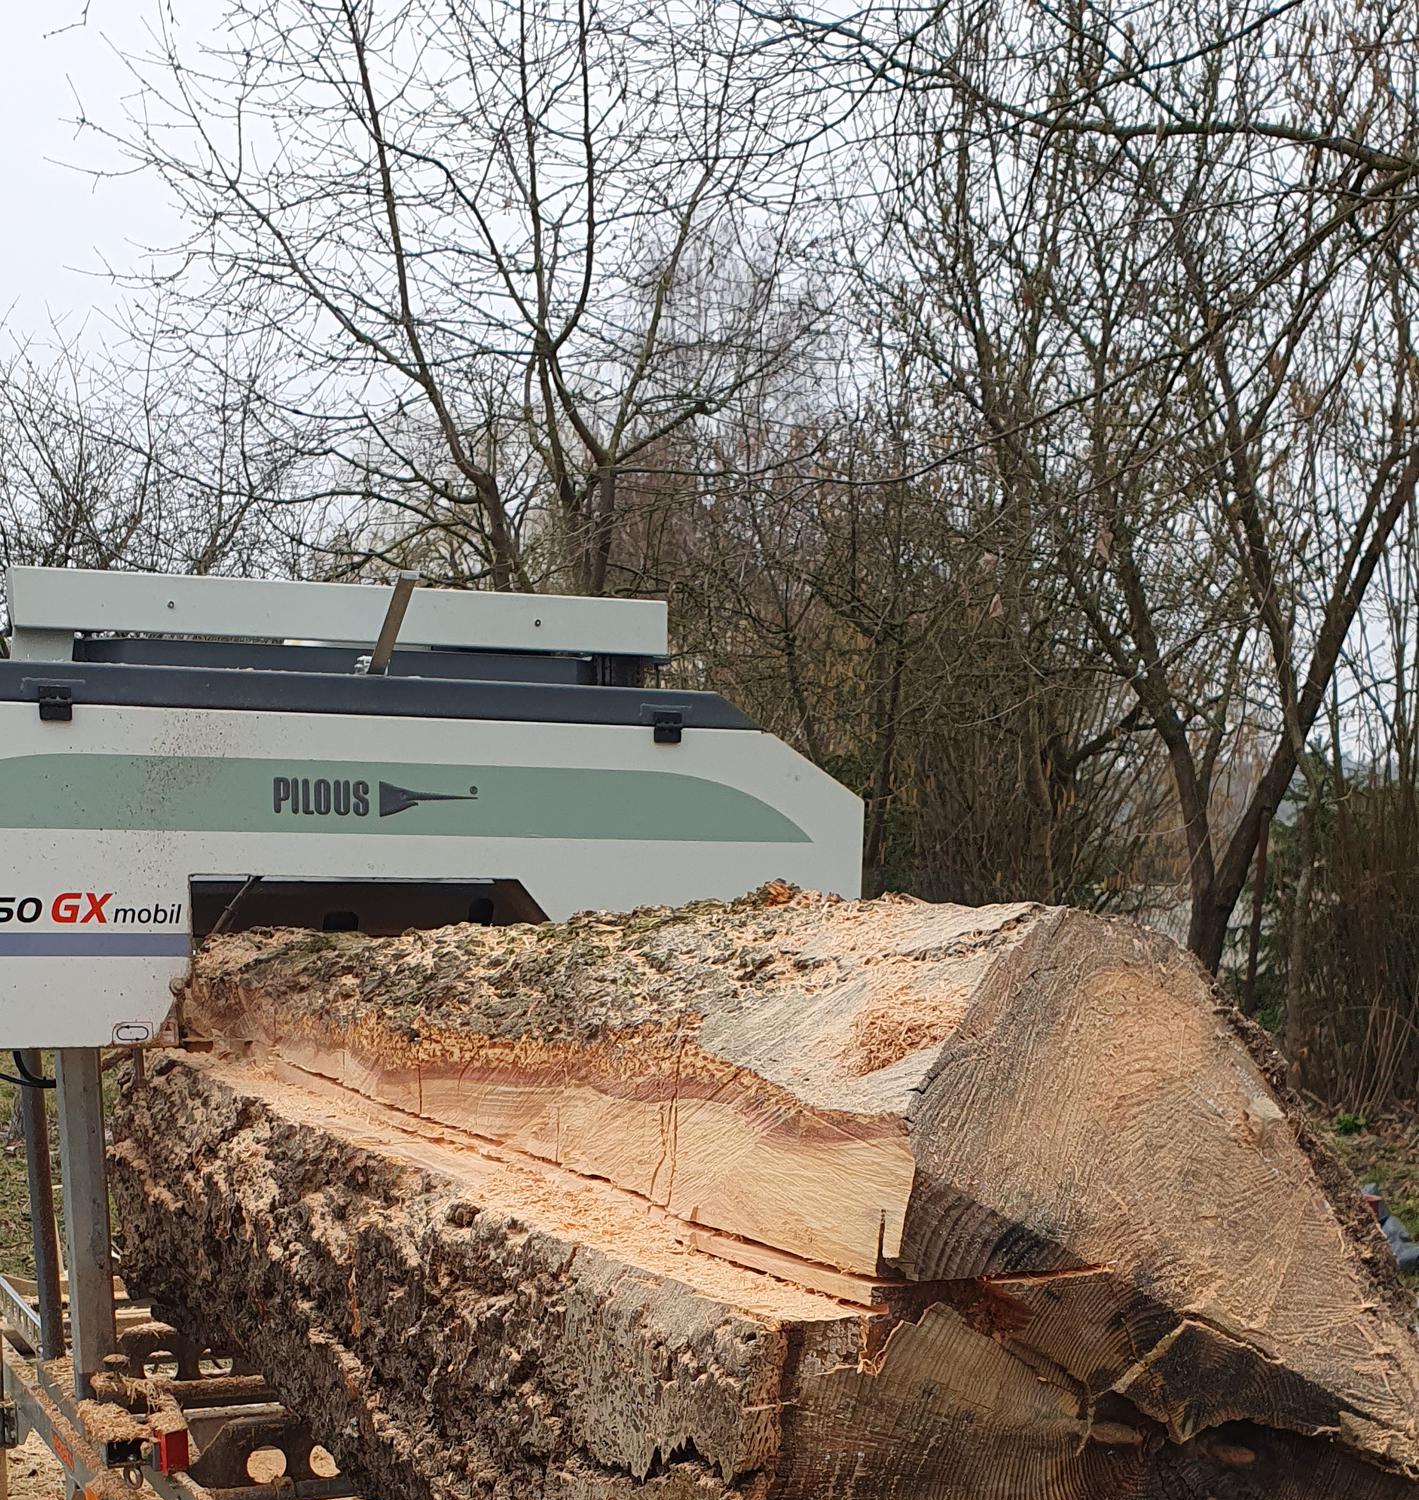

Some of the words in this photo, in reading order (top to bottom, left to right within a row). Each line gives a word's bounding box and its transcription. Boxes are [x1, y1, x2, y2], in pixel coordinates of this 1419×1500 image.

[273, 776, 370, 817] PILOUS
[51, 892, 113, 924] GX
[113, 903, 182, 924] mobil
